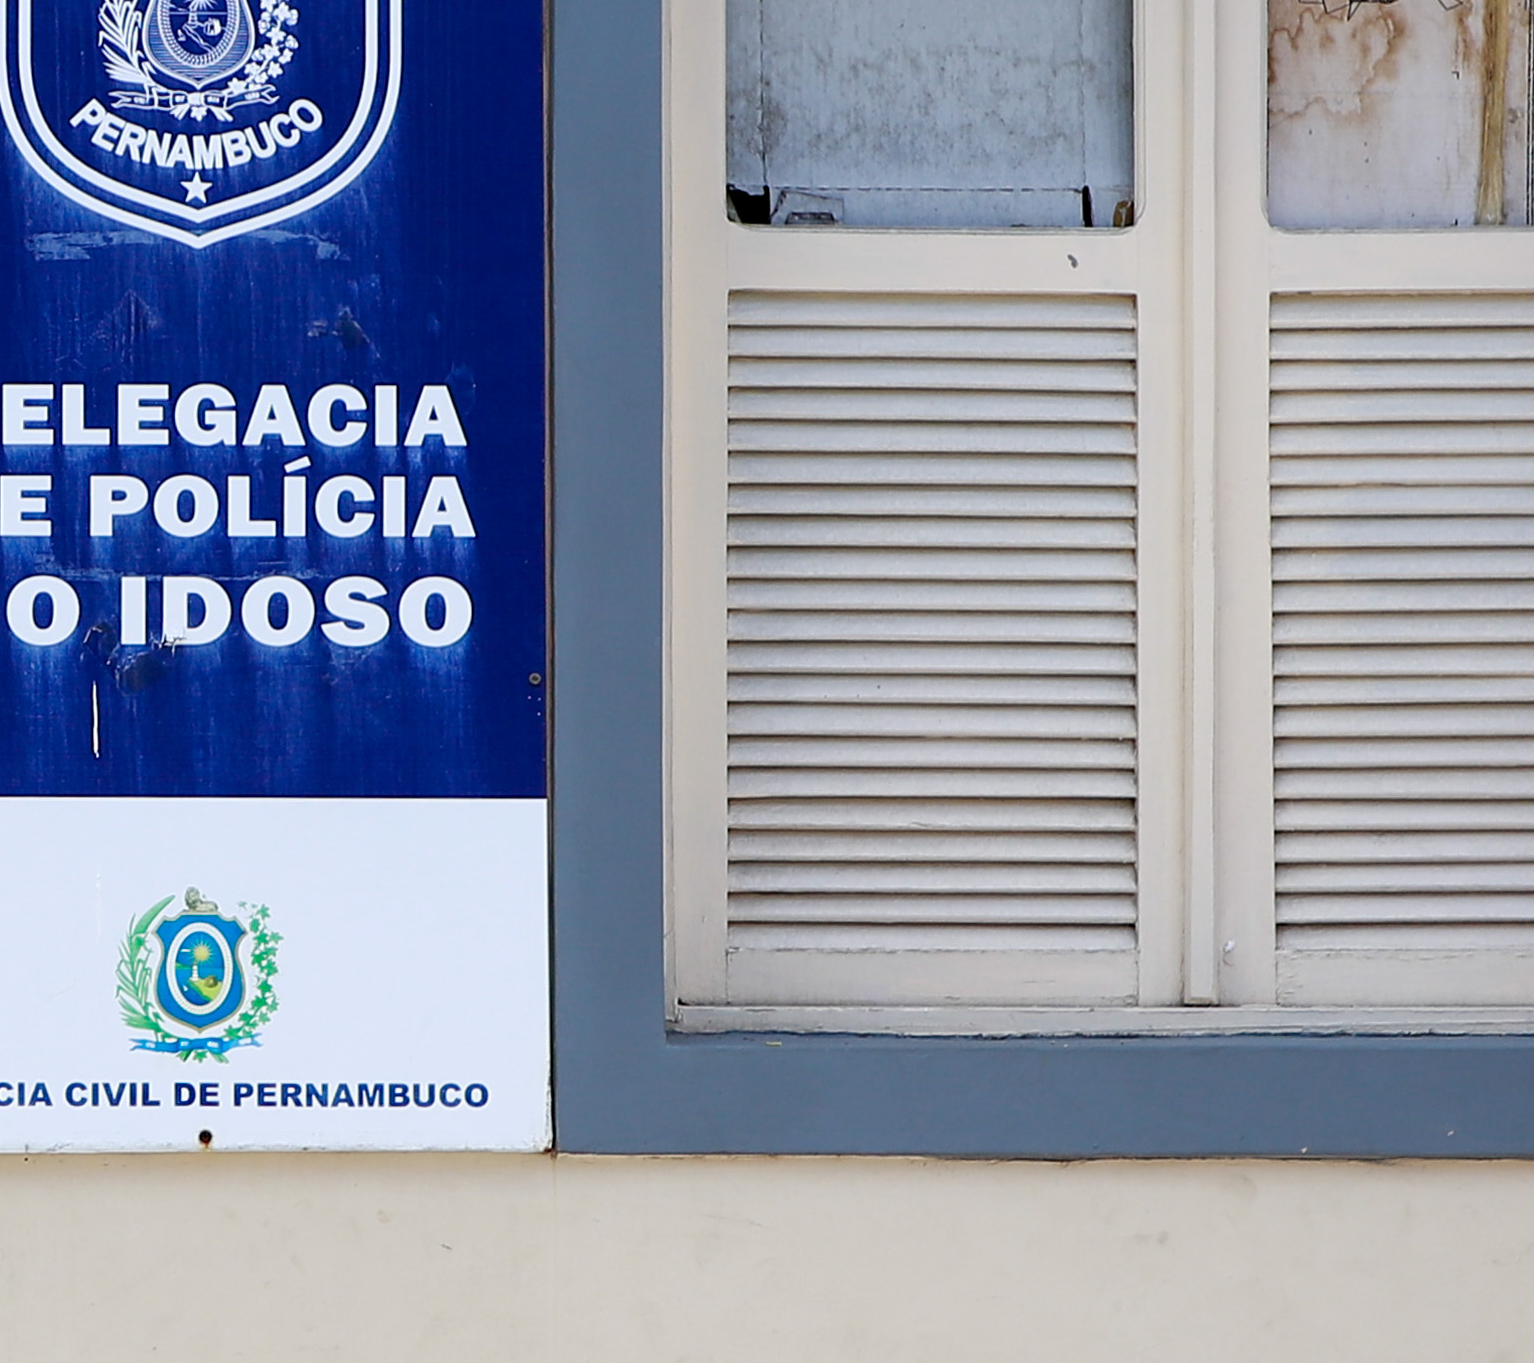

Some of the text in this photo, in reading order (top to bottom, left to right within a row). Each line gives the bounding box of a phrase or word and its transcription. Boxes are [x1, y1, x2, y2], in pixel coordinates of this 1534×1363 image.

[71, 99, 323, 169] PERNAMBUCO
[91, 457, 475, 537] POLÍCIA
[122, 576, 471, 646] IDOSO
[66, 1082, 160, 1106] CIVIL
[174, 1082, 219, 1106] DE
[234, 1083, 488, 1107] PERNAMBUCO
